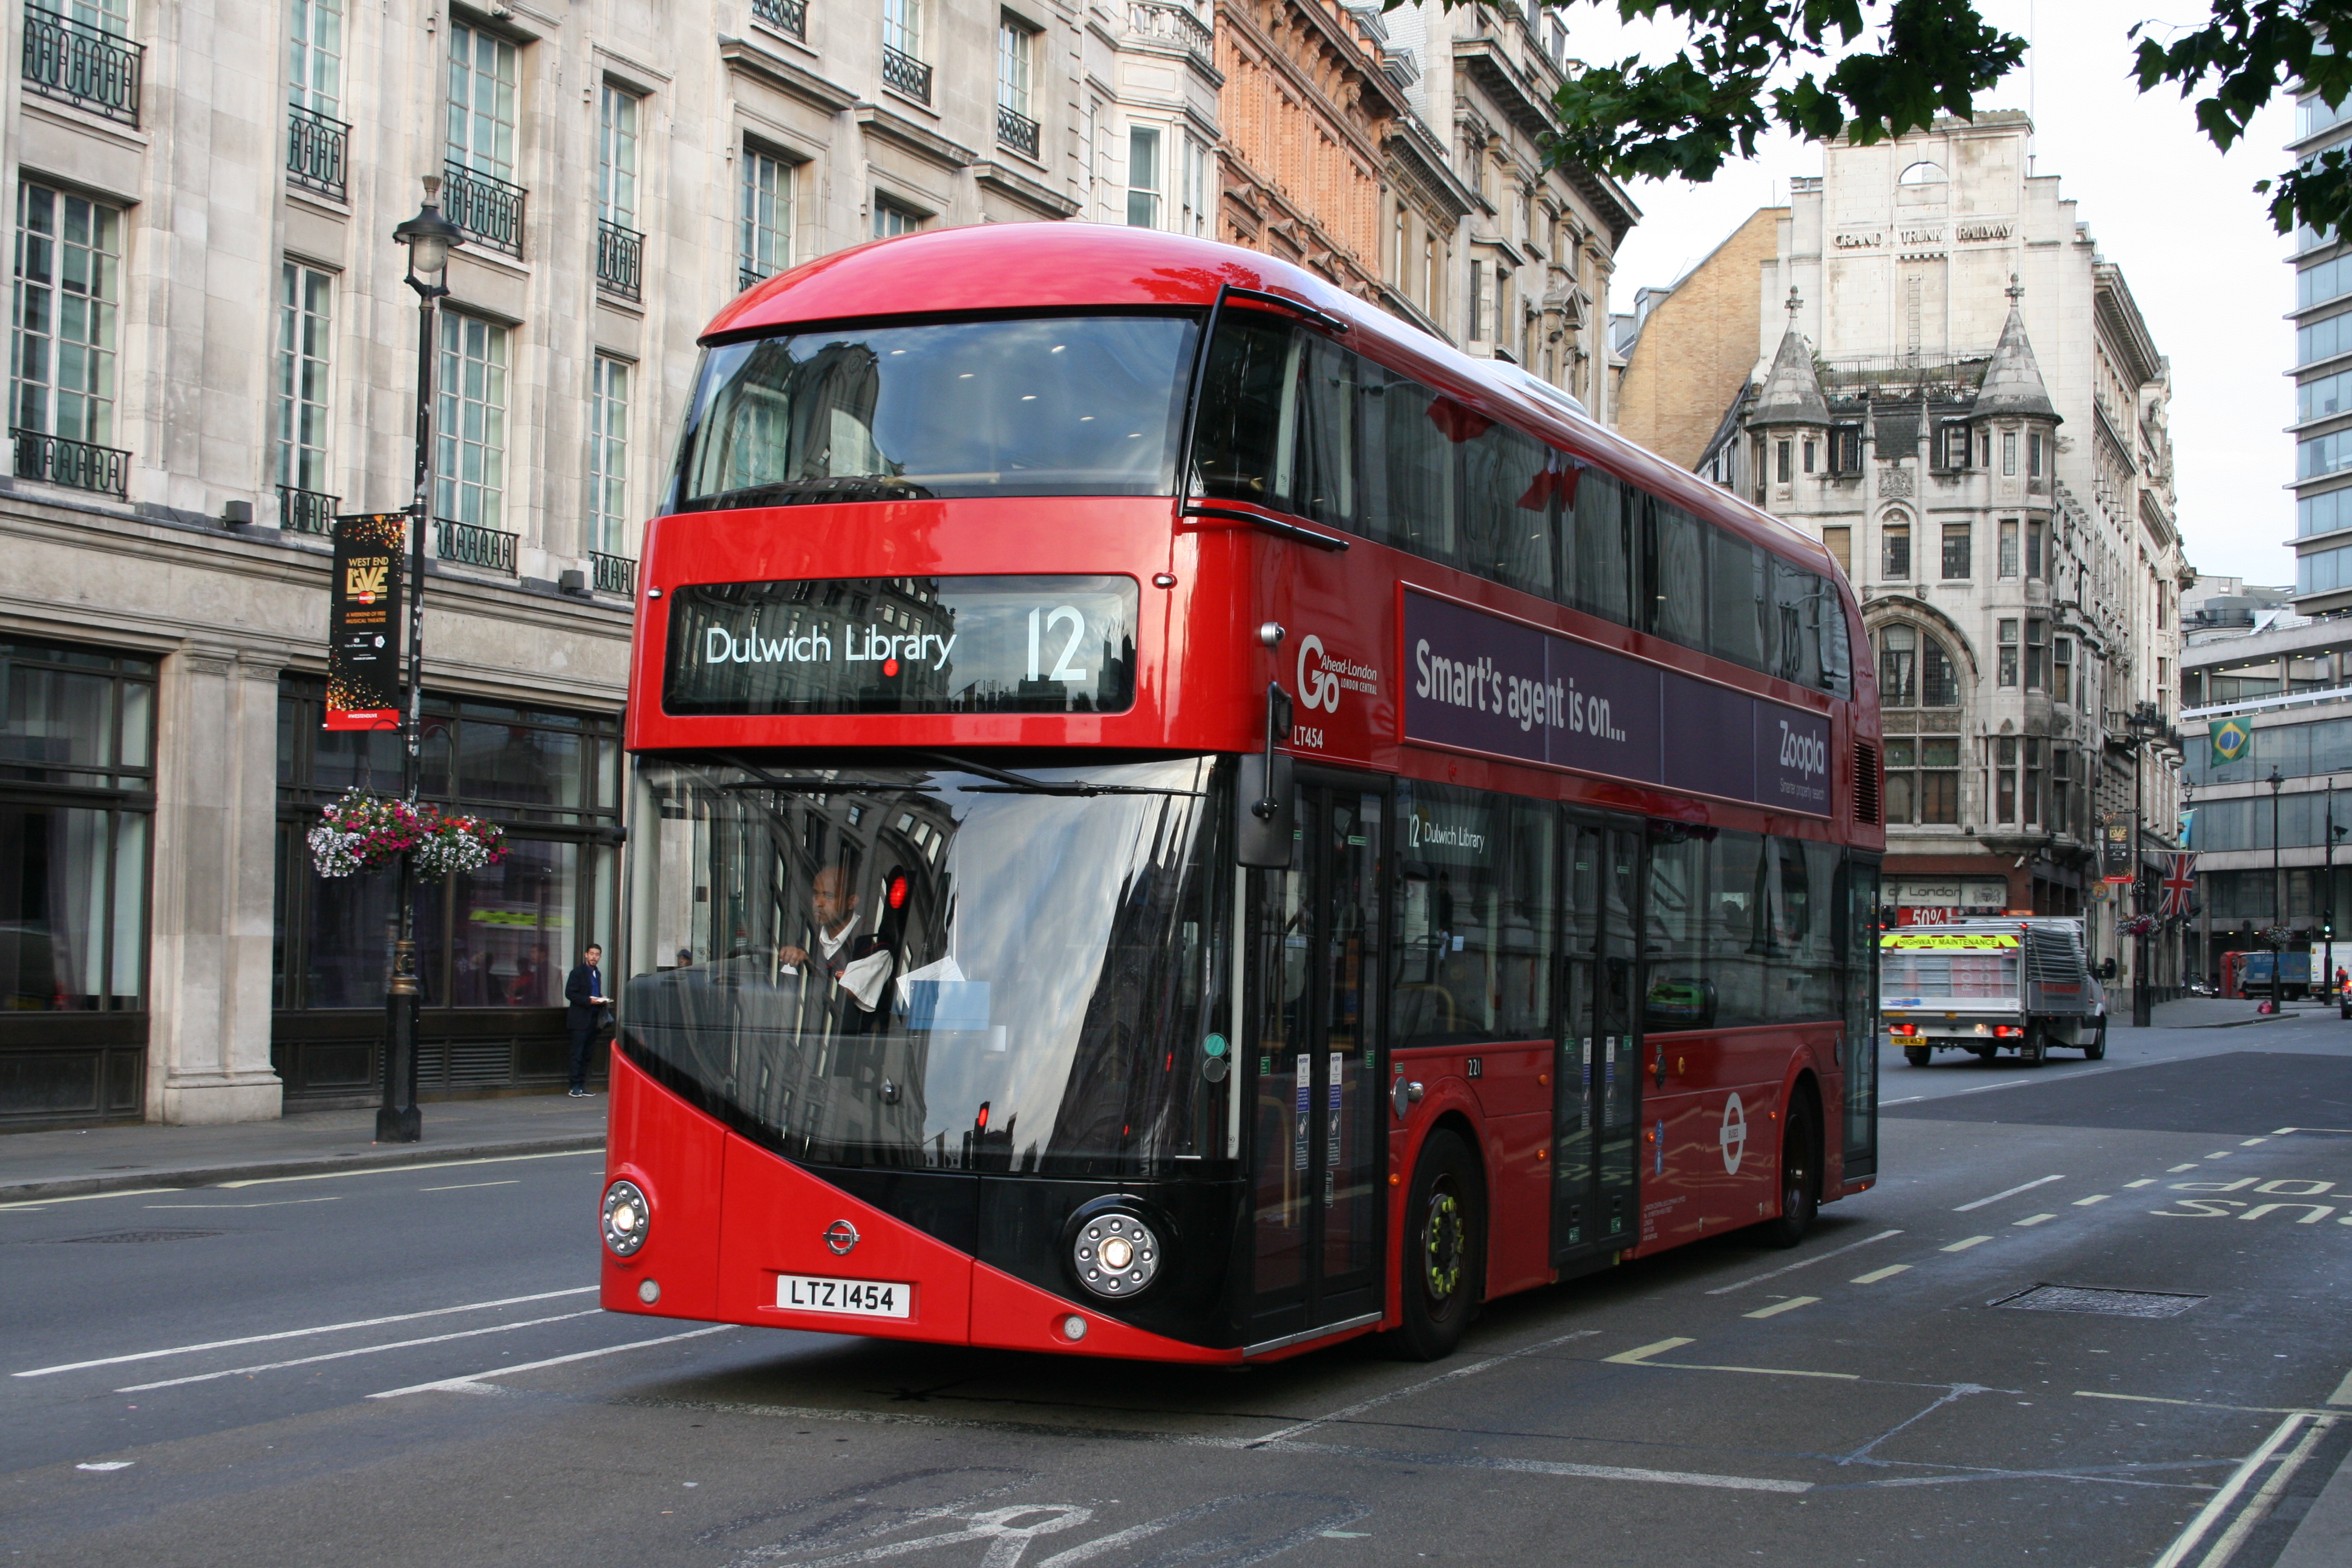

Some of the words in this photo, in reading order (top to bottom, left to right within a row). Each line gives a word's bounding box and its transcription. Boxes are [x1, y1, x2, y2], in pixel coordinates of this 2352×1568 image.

[1833, 232, 1883, 247] GRAND
[1900, 227, 1944, 243] TRUNK
[1958, 223, 2015, 240] RAILWAY
[348, 557, 371, 567] WEST
[373, 557, 389, 566] END
[347, 566, 389, 594] LIVE
[706, 625, 831, 664] Dulwich
[846, 624, 957, 671] Library
[1027, 605, 1087, 682] 12
[1297, 634, 1340, 714] Go
[1341, 678, 1359, 691] LONDON
[1359, 682, 1377, 695] CENTRAL
[1416, 638, 1503, 715] Smart's
[1508, 675, 1564, 732] agent
[1569, 677, 1584, 733] is
[1588, 696, 1626, 743] on...
[1293, 725, 1324, 749] LT454
[1779, 719, 1824, 781] Zoopla
[1779, 777, 1796, 795] Smarter
[1796, 785, 1812, 802] property
[1812, 787, 1825, 800] search
[1409, 814, 1420, 848] 12
[1424, 822, 1456, 846] Dulwich
[1459, 826, 1485, 854] Library
[1888, 886, 1904, 897] of
[1909, 886, 1962, 897] London
[1912, 909, 1944, 926] 50%
[1468, 1059, 1481, 1076] 221
